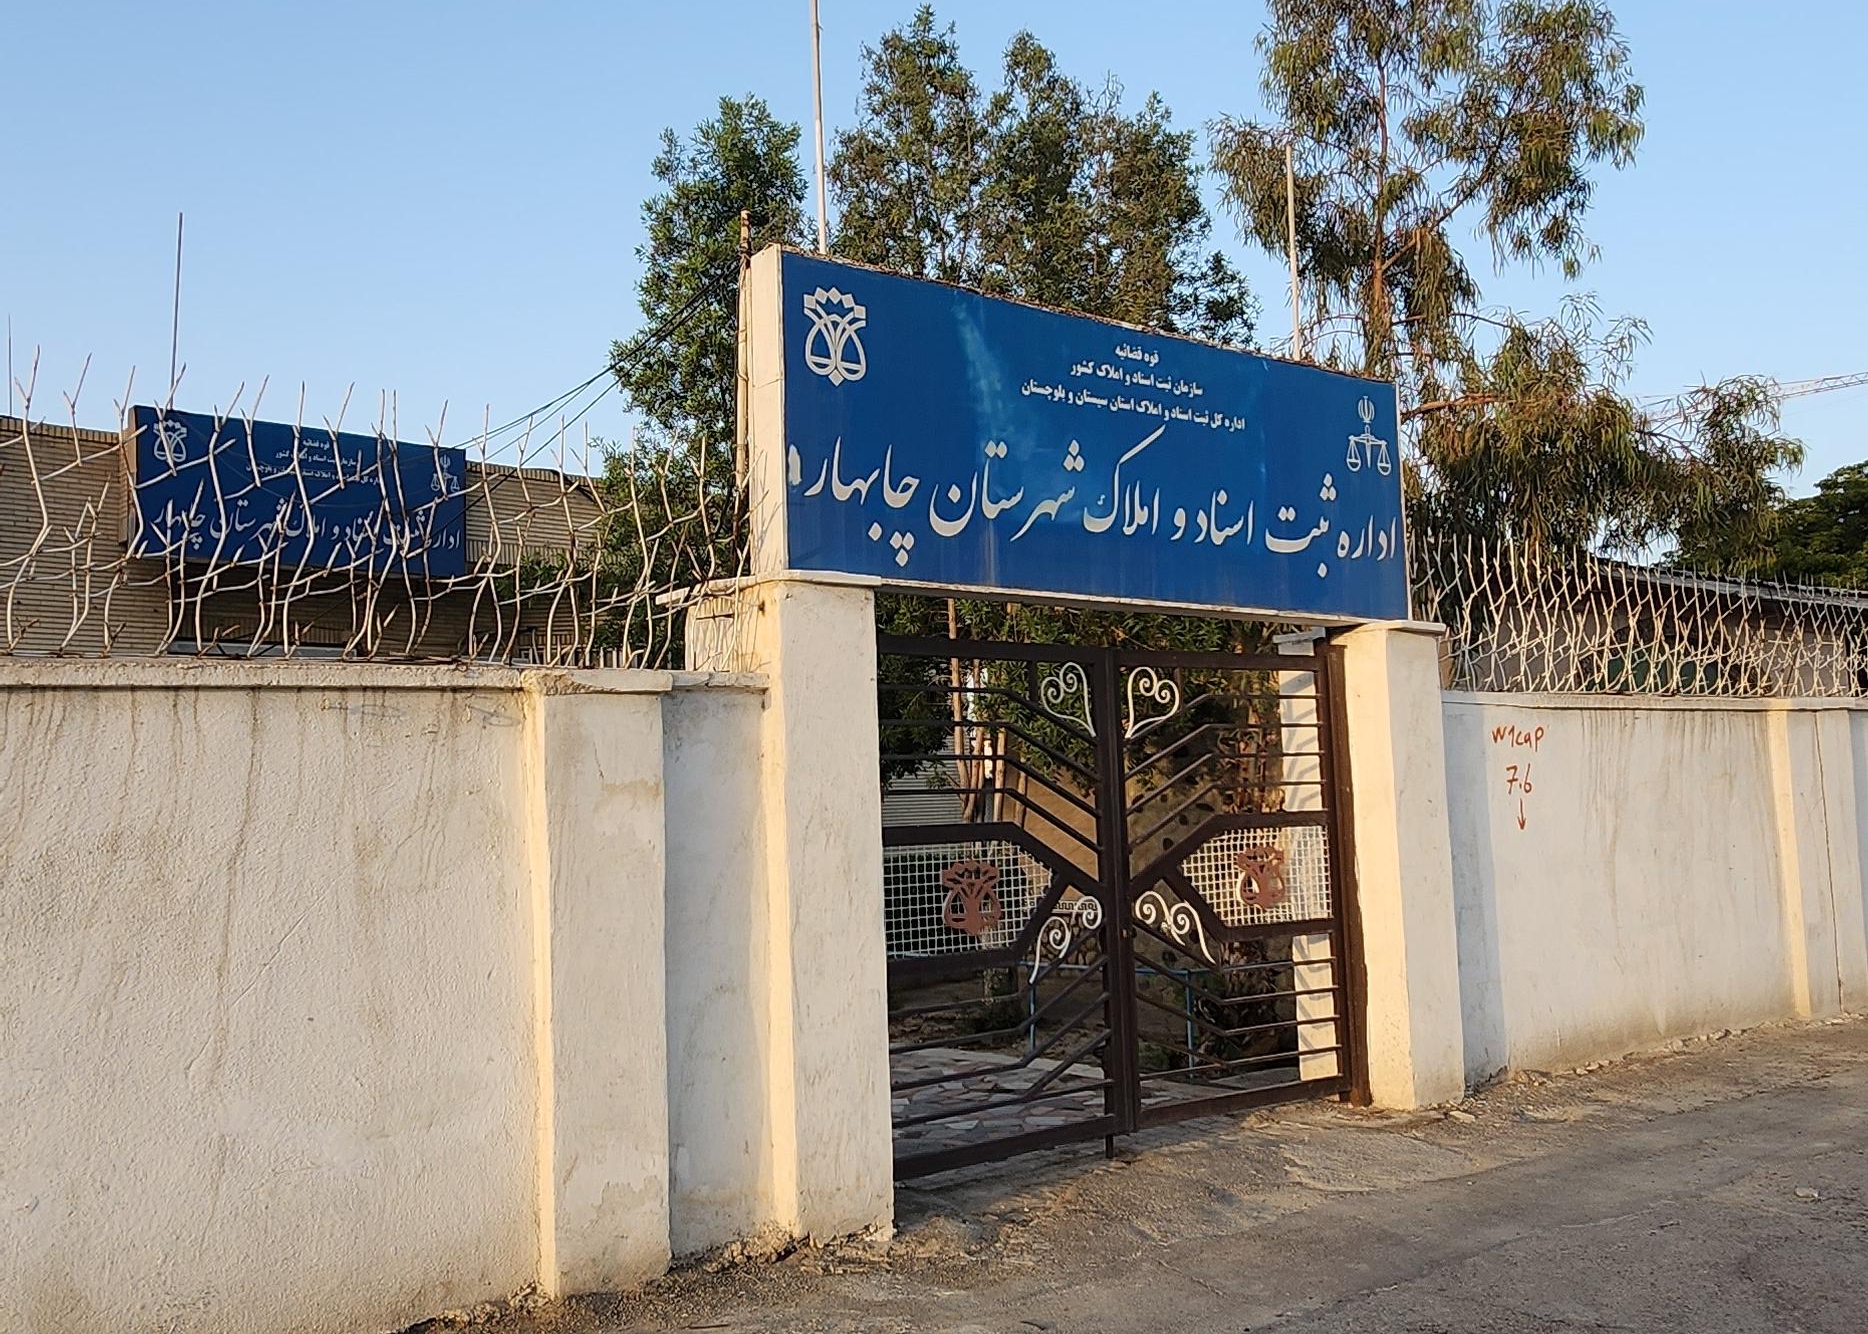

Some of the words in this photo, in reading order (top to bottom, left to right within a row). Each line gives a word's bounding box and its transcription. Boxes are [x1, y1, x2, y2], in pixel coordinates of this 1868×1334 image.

[1115, 343, 1142, 361] قضائیه
[1144, 349, 1160, 366] قوه
[1070, 360, 1095, 376] کشور
[1096, 363, 1124, 381] املاک
[1124, 373, 1131, 386] و
[1131, 371, 1155, 387] اسناد
[1155, 375, 1172, 390] ثبت
[1021, 378, 1066, 403] بلوچستان
[1067, 391, 1074, 404] و
[1075, 387, 1108, 408] سیستان
[1172, 380, 1204, 398] سازمان
[1108, 395, 1135, 412] استان
[1135, 398, 1162, 415] املاک
[1163, 408, 1170, 421] و
[1170, 405, 1192, 421] اسناد
[1193, 409, 1209, 424] ثبت
[1210, 412, 1223, 429] کل
[1224, 416, 1246, 432] اداره
[1083, 424, 1166, 536] املاک
[929, 439, 1085, 542] شهرستان
[803, 436, 920, 567] چابهار
[1170, 507, 1187, 541] و
[1194, 489, 1254, 545] اسناد
[1265, 473, 1337, 578] ثبت
[1337, 514, 1396, 561] اداره
